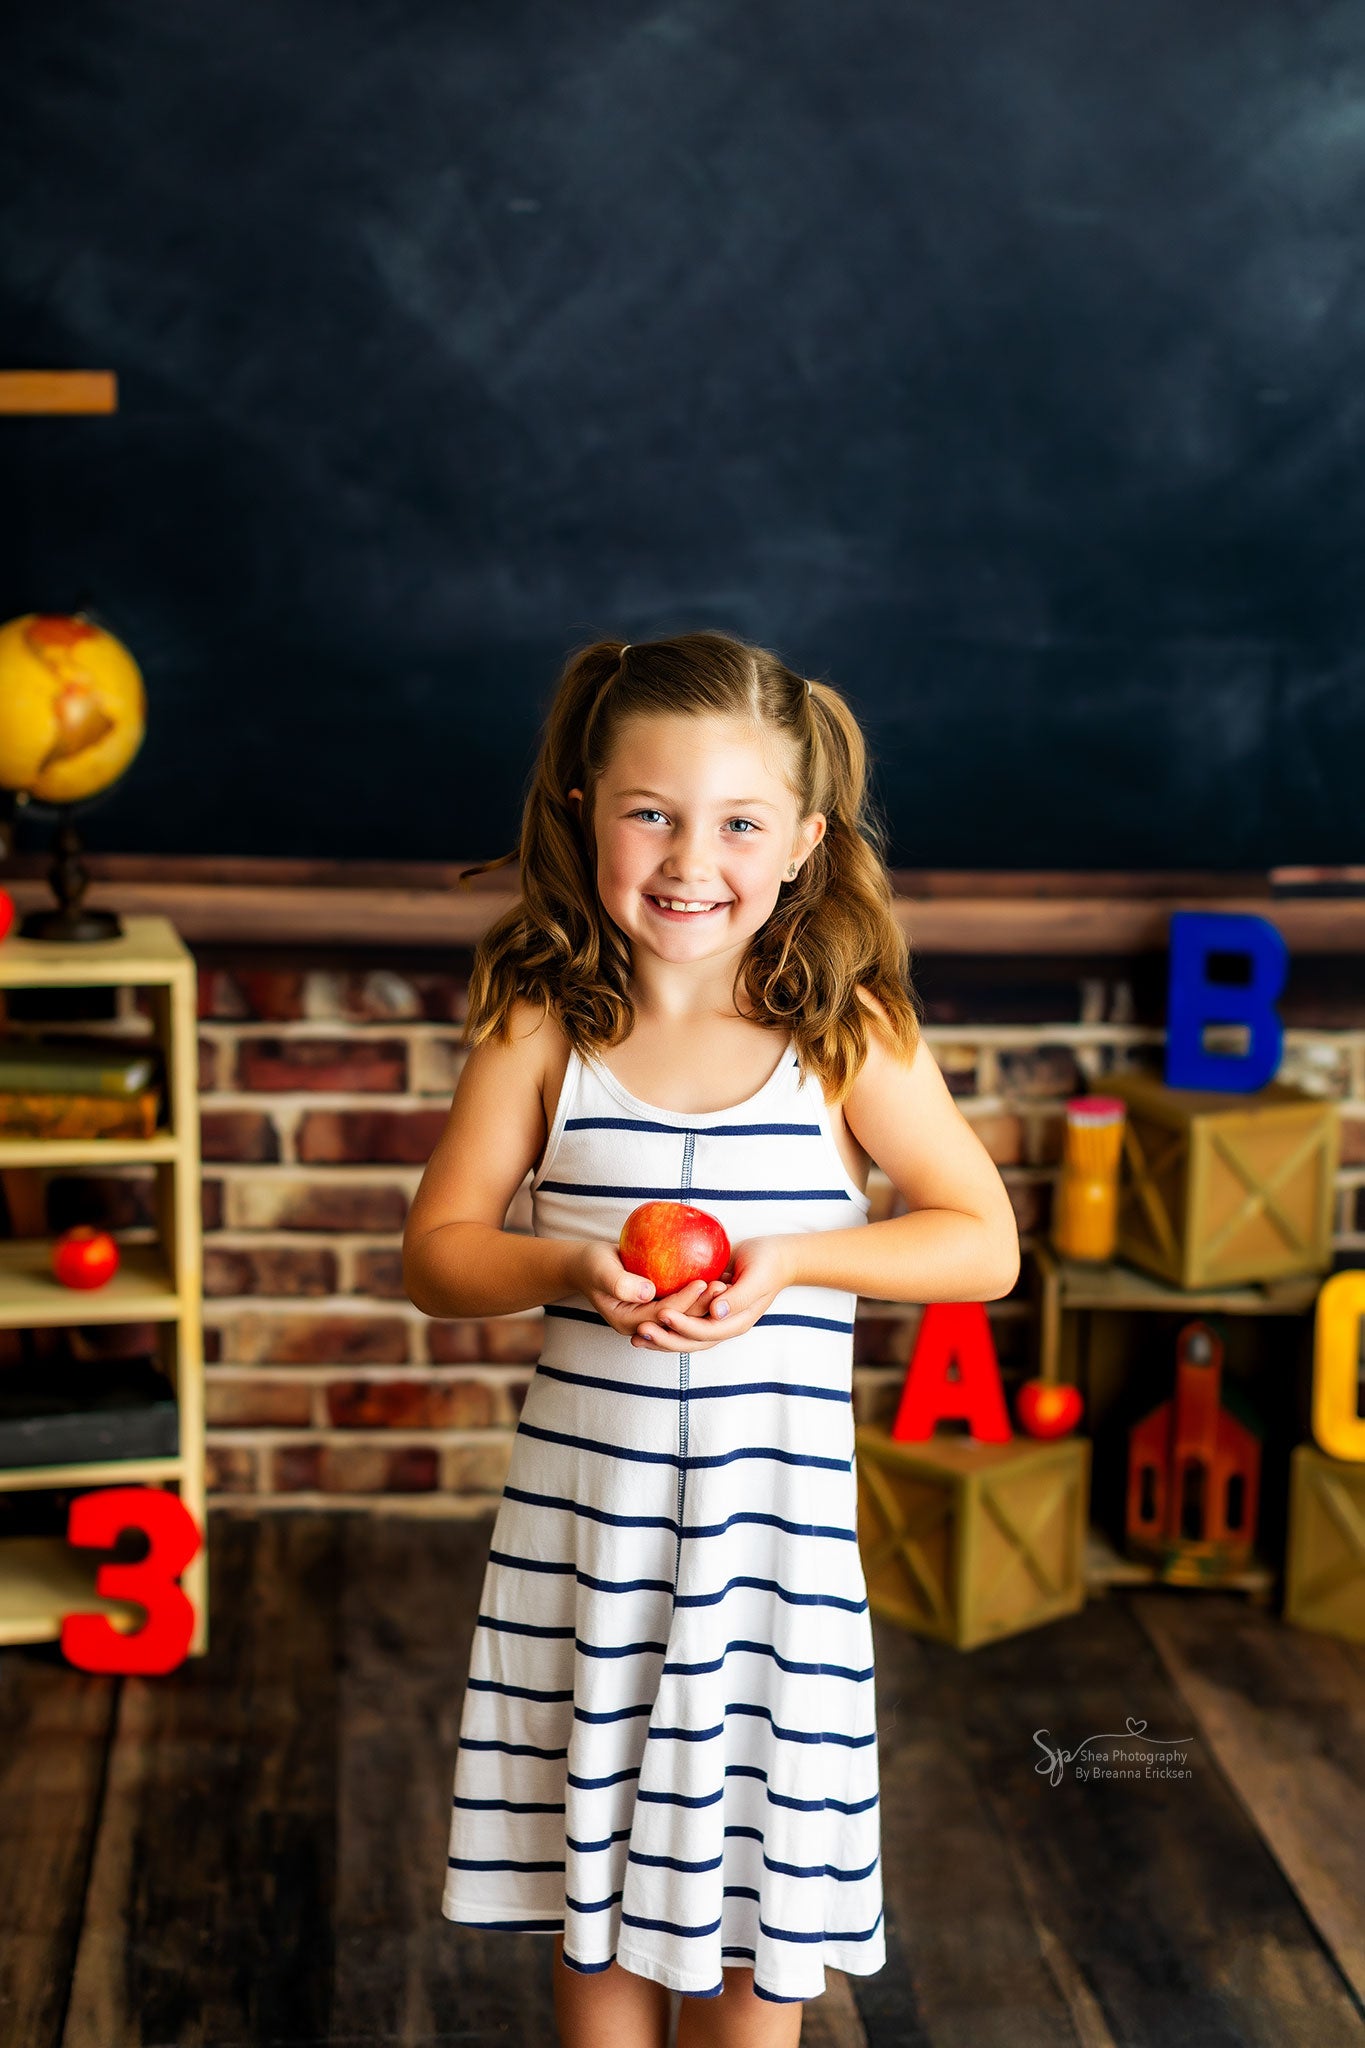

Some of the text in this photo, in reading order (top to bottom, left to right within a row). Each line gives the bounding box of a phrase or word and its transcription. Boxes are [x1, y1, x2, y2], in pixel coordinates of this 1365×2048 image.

[1166, 911, 1288, 1092] B
[892, 1302, 1012, 1443] A
[60, 1487, 202, 1675] 3
